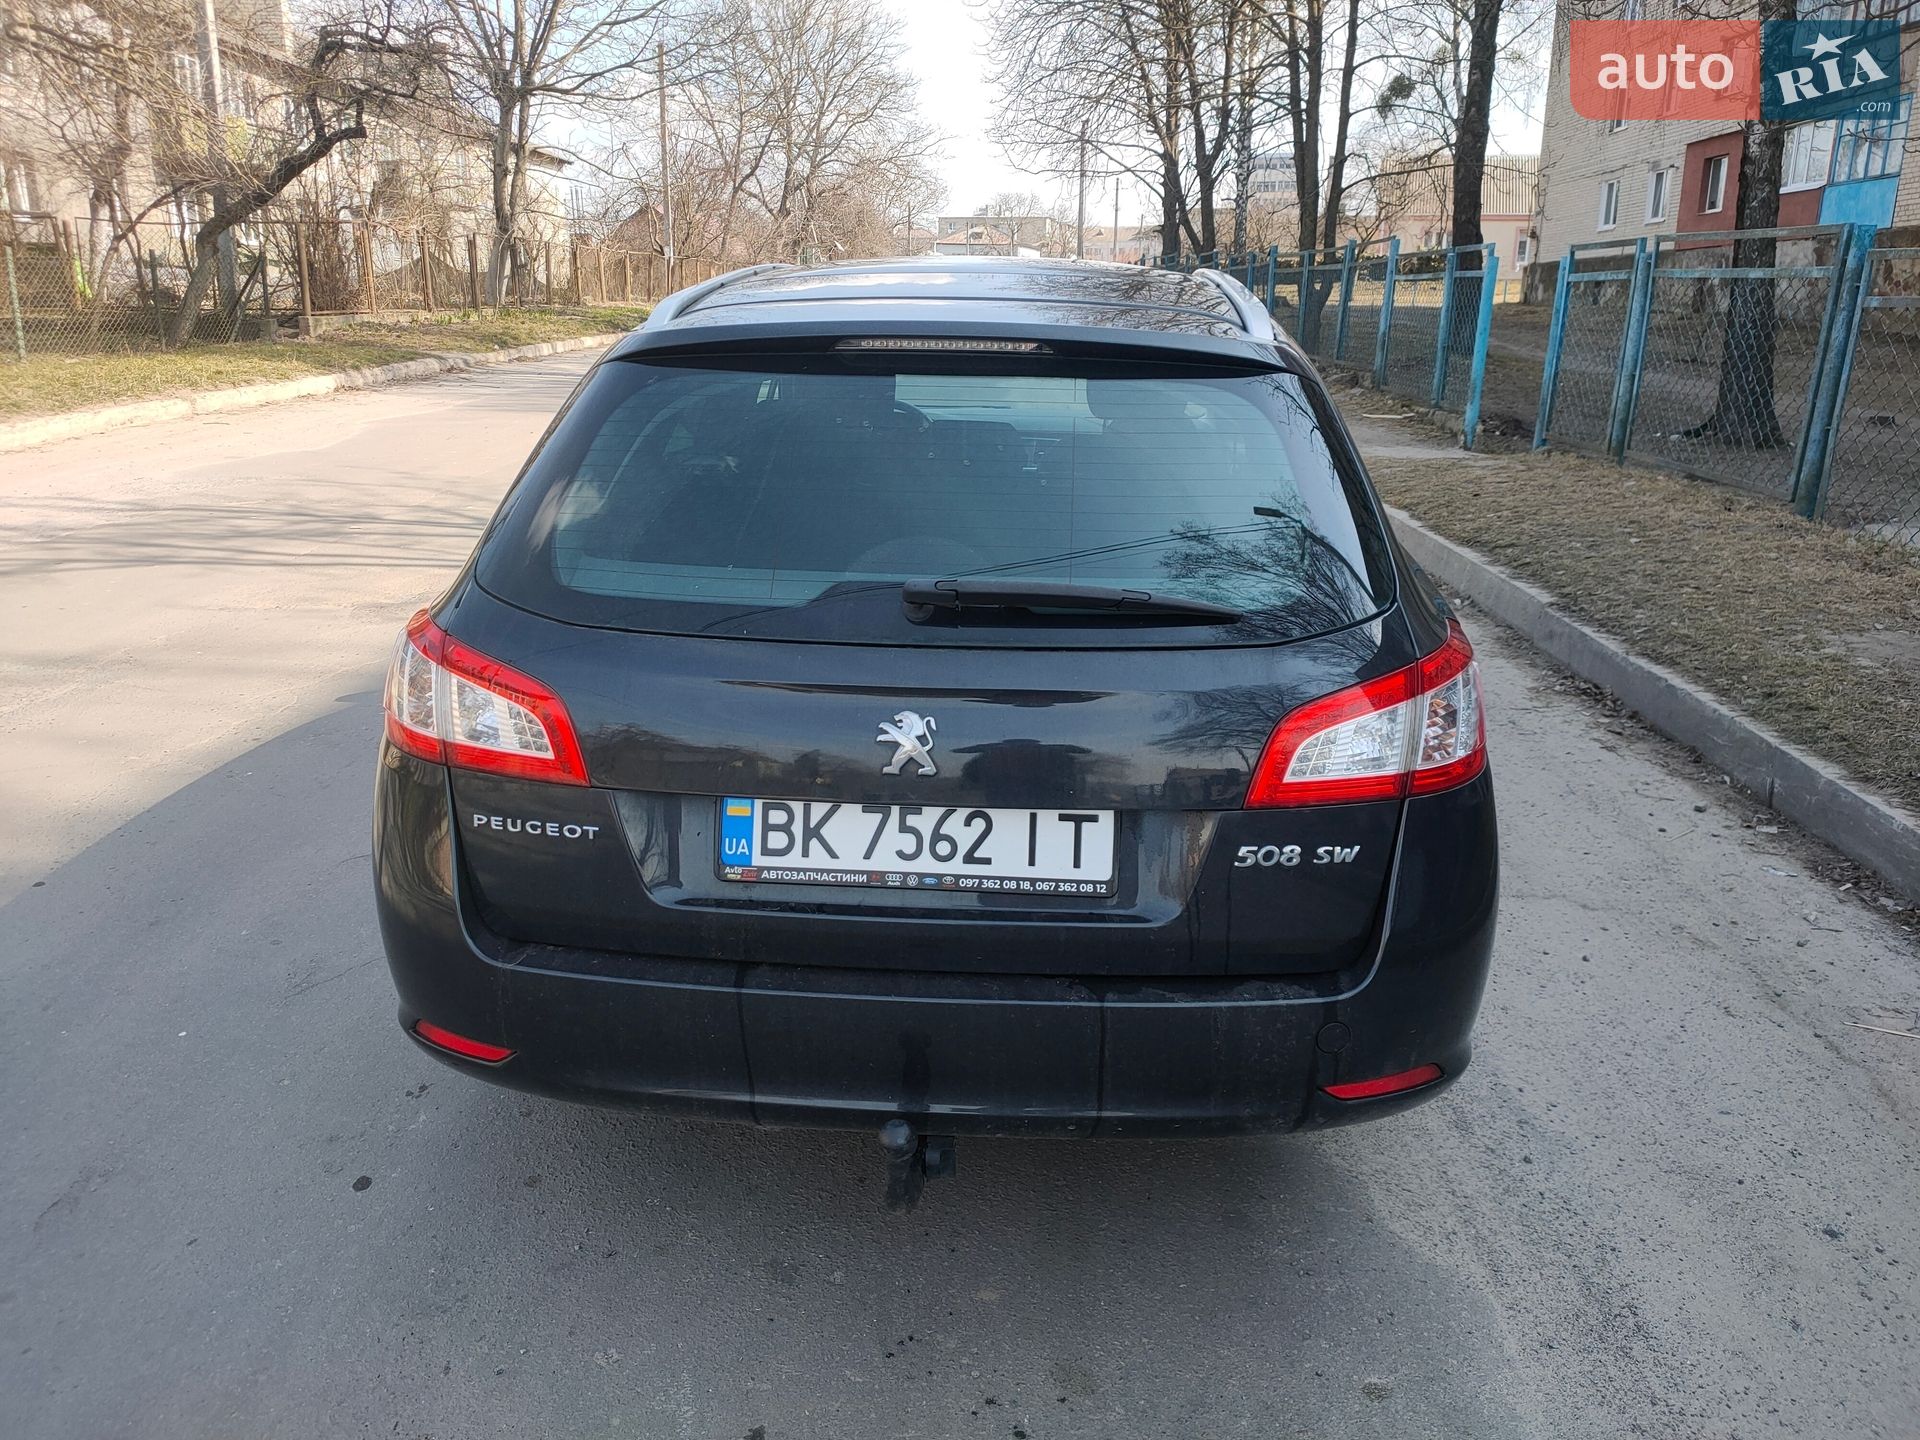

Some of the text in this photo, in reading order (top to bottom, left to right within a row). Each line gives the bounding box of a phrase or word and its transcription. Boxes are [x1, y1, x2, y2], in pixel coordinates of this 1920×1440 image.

[473, 813, 600, 840] PEUGEOT
[759, 801, 1100, 869] BK 7562 IT
[724, 838, 750, 856] UA
[1234, 844, 1361, 868] 508 SW
[761, 869, 868, 883] АВТОЗАПЧАСТИНИ
[959, 878, 979, 888] 097
[981, 879, 1001, 889] 362
[1003, 881, 1017, 889] 08
[1035, 882, 1056, 891] 067
[1058, 882, 1078, 892] 362
[1080, 883, 1094, 893] 08
[1097, 884, 1107, 893] 12
